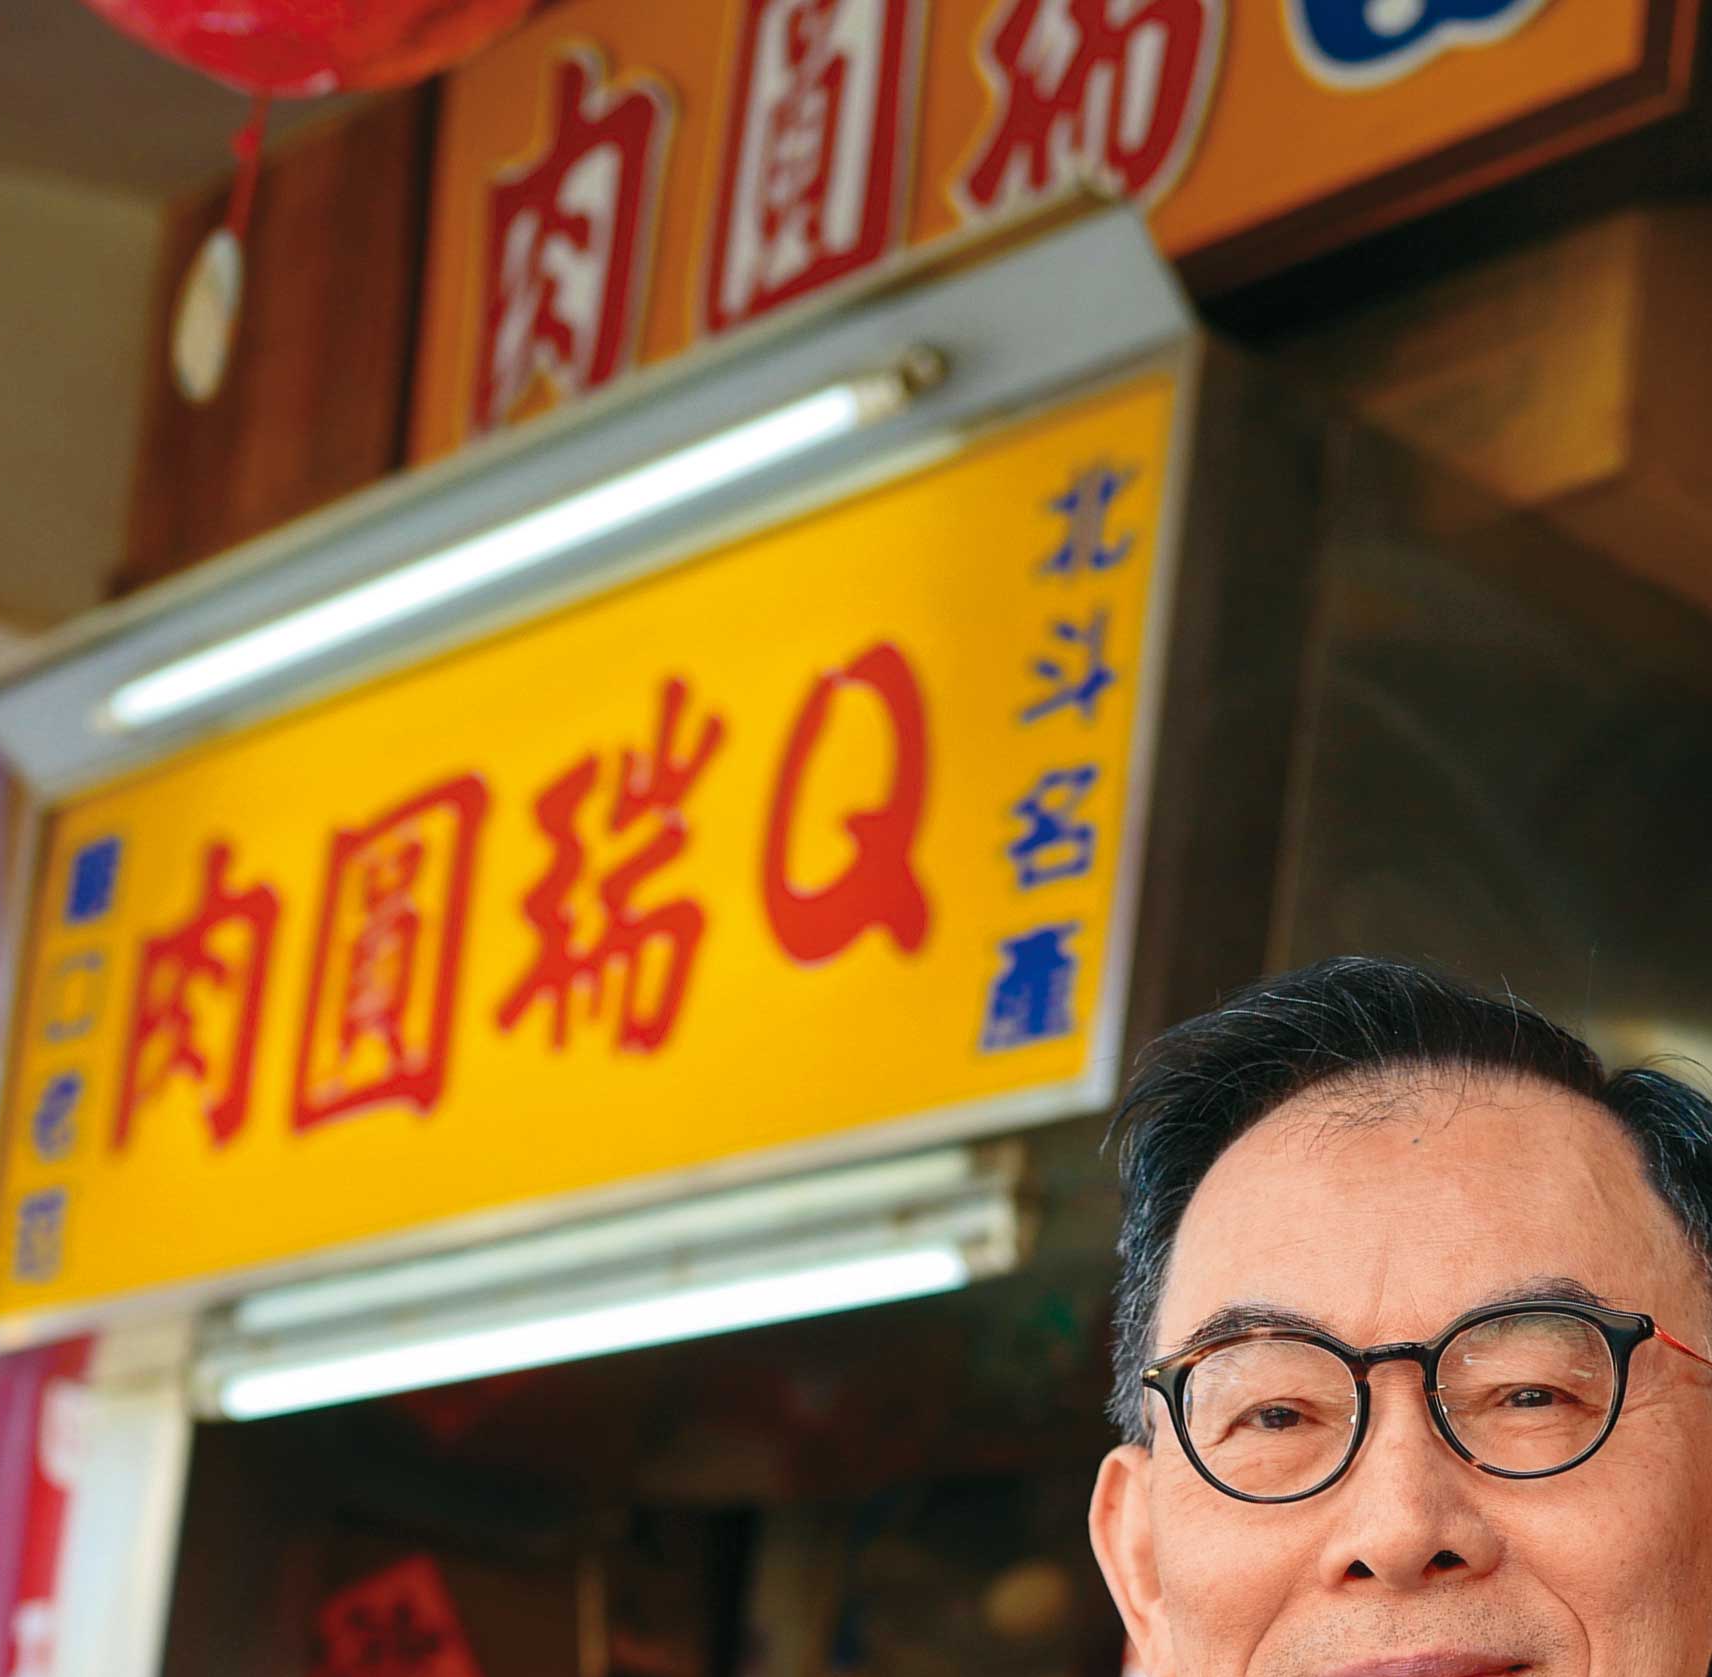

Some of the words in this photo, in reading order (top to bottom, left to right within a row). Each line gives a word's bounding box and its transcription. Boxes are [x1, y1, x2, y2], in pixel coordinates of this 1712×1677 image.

[478, 0, 1550, 442] 肉圓瑞
[108, 635, 938, 1157] 肉圓瑞Q
[978, 455, 1138, 1058] 北斗名產
